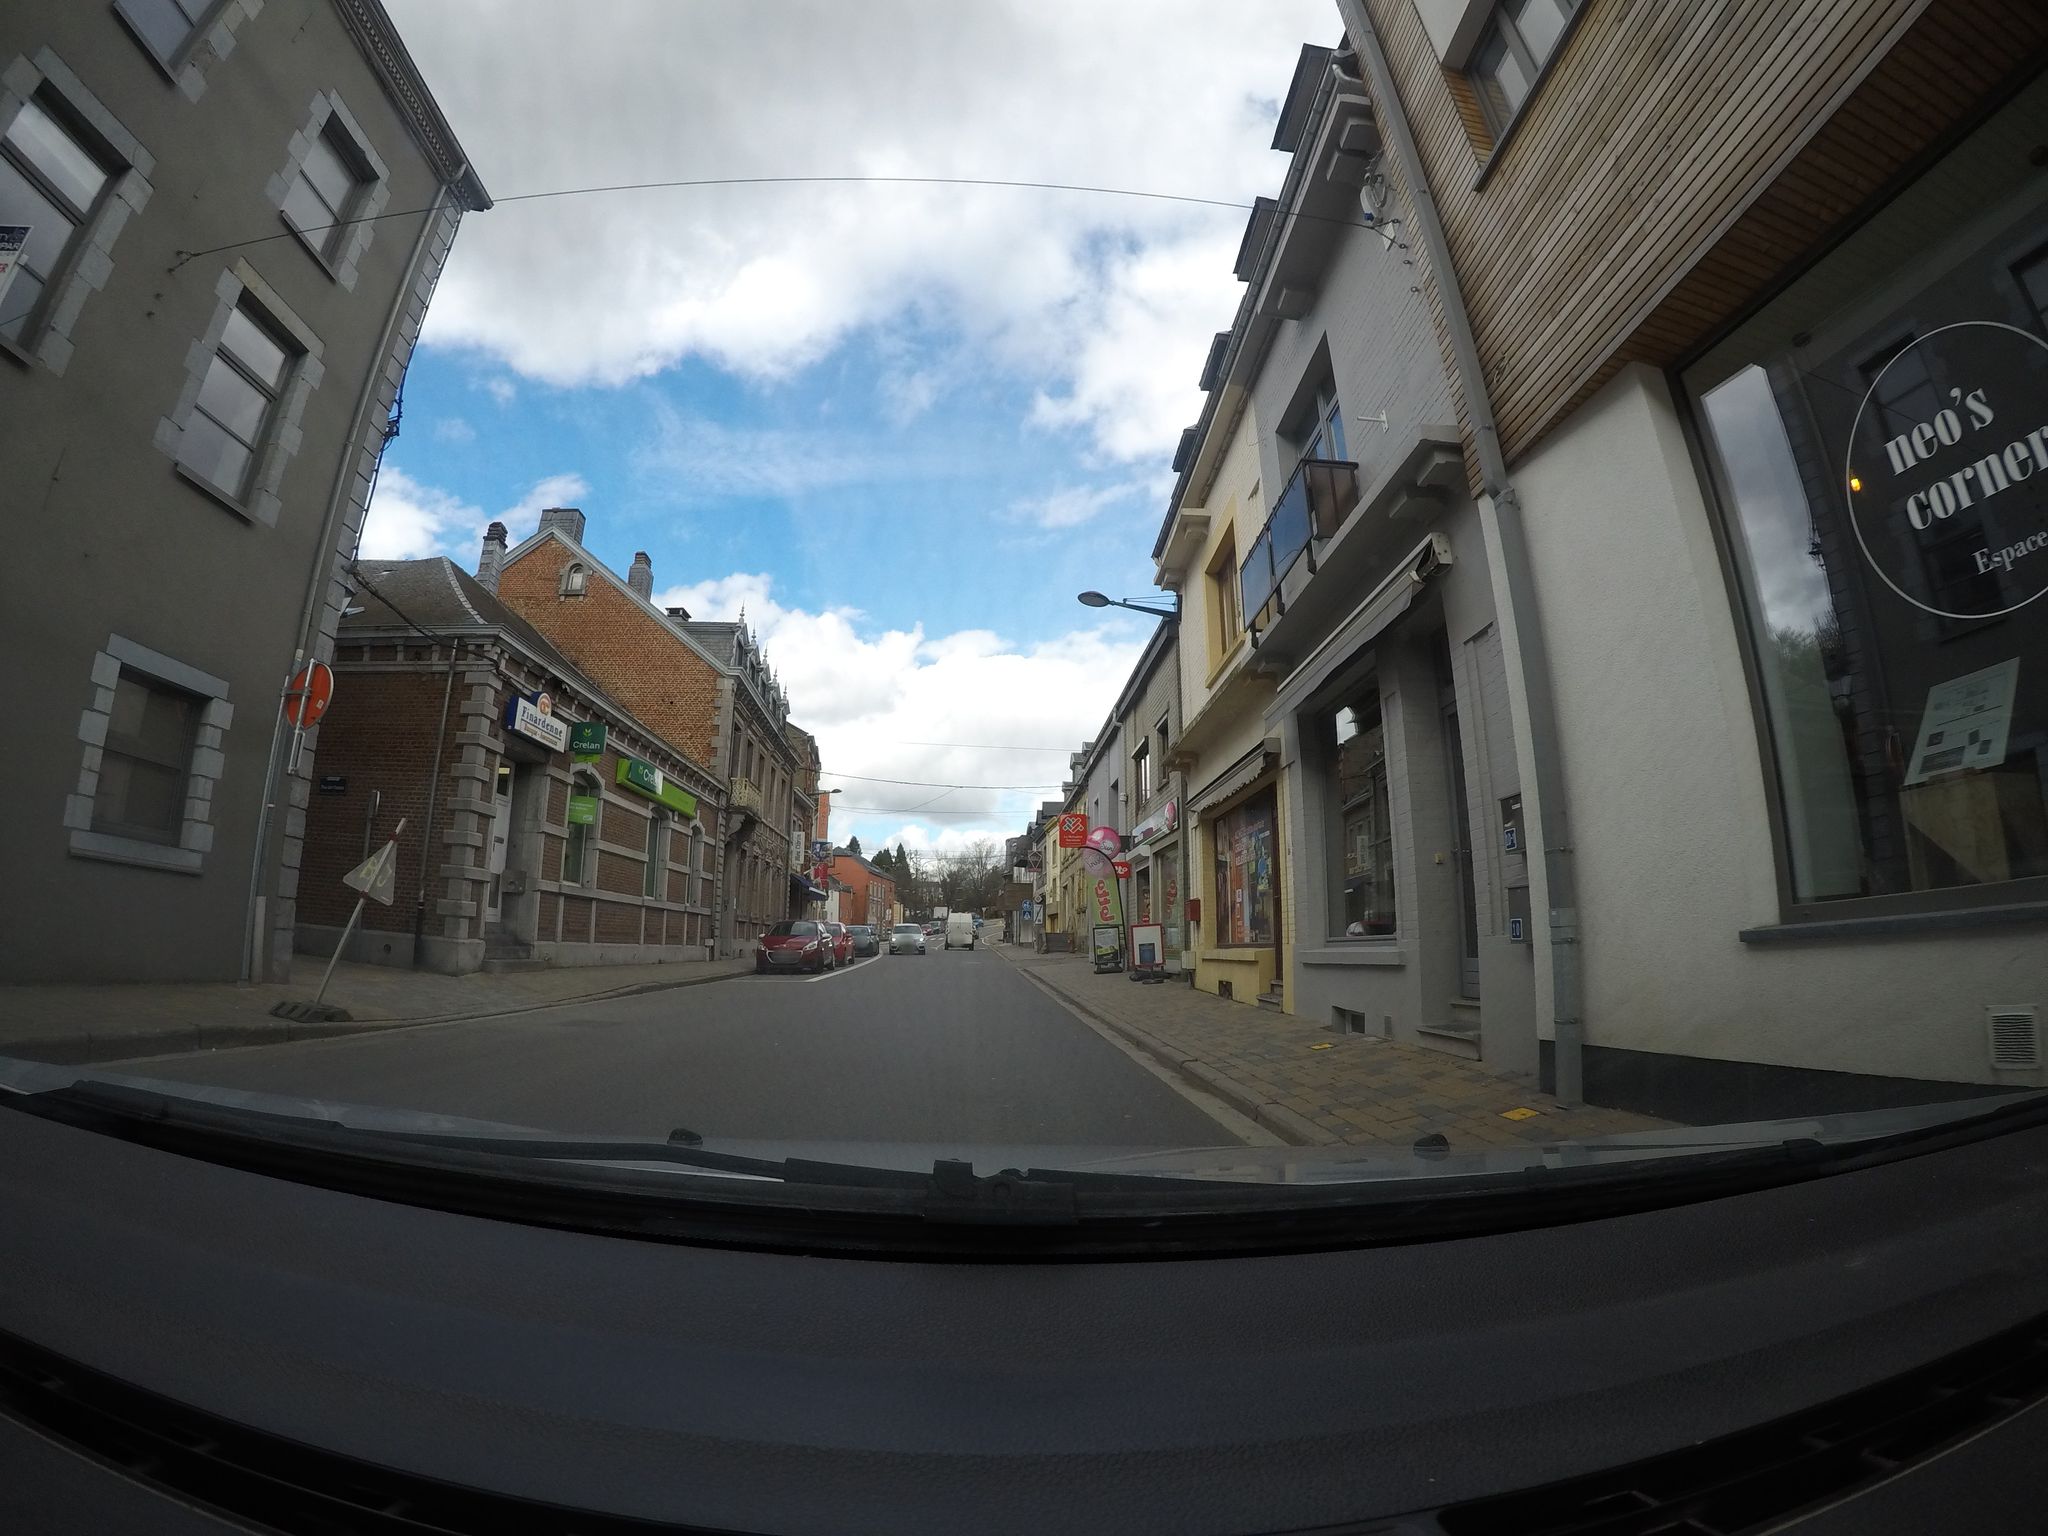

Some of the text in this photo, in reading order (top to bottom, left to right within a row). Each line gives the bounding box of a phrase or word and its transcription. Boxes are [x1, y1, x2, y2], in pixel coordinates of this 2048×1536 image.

[1883, 387, 1995, 476] neo's
[1906, 425, 2048, 530] corner
[1971, 531, 2048, 575] Espace
[521, 706, 563, 737] Finardenne
[572, 741, 600, 750] Crelan
